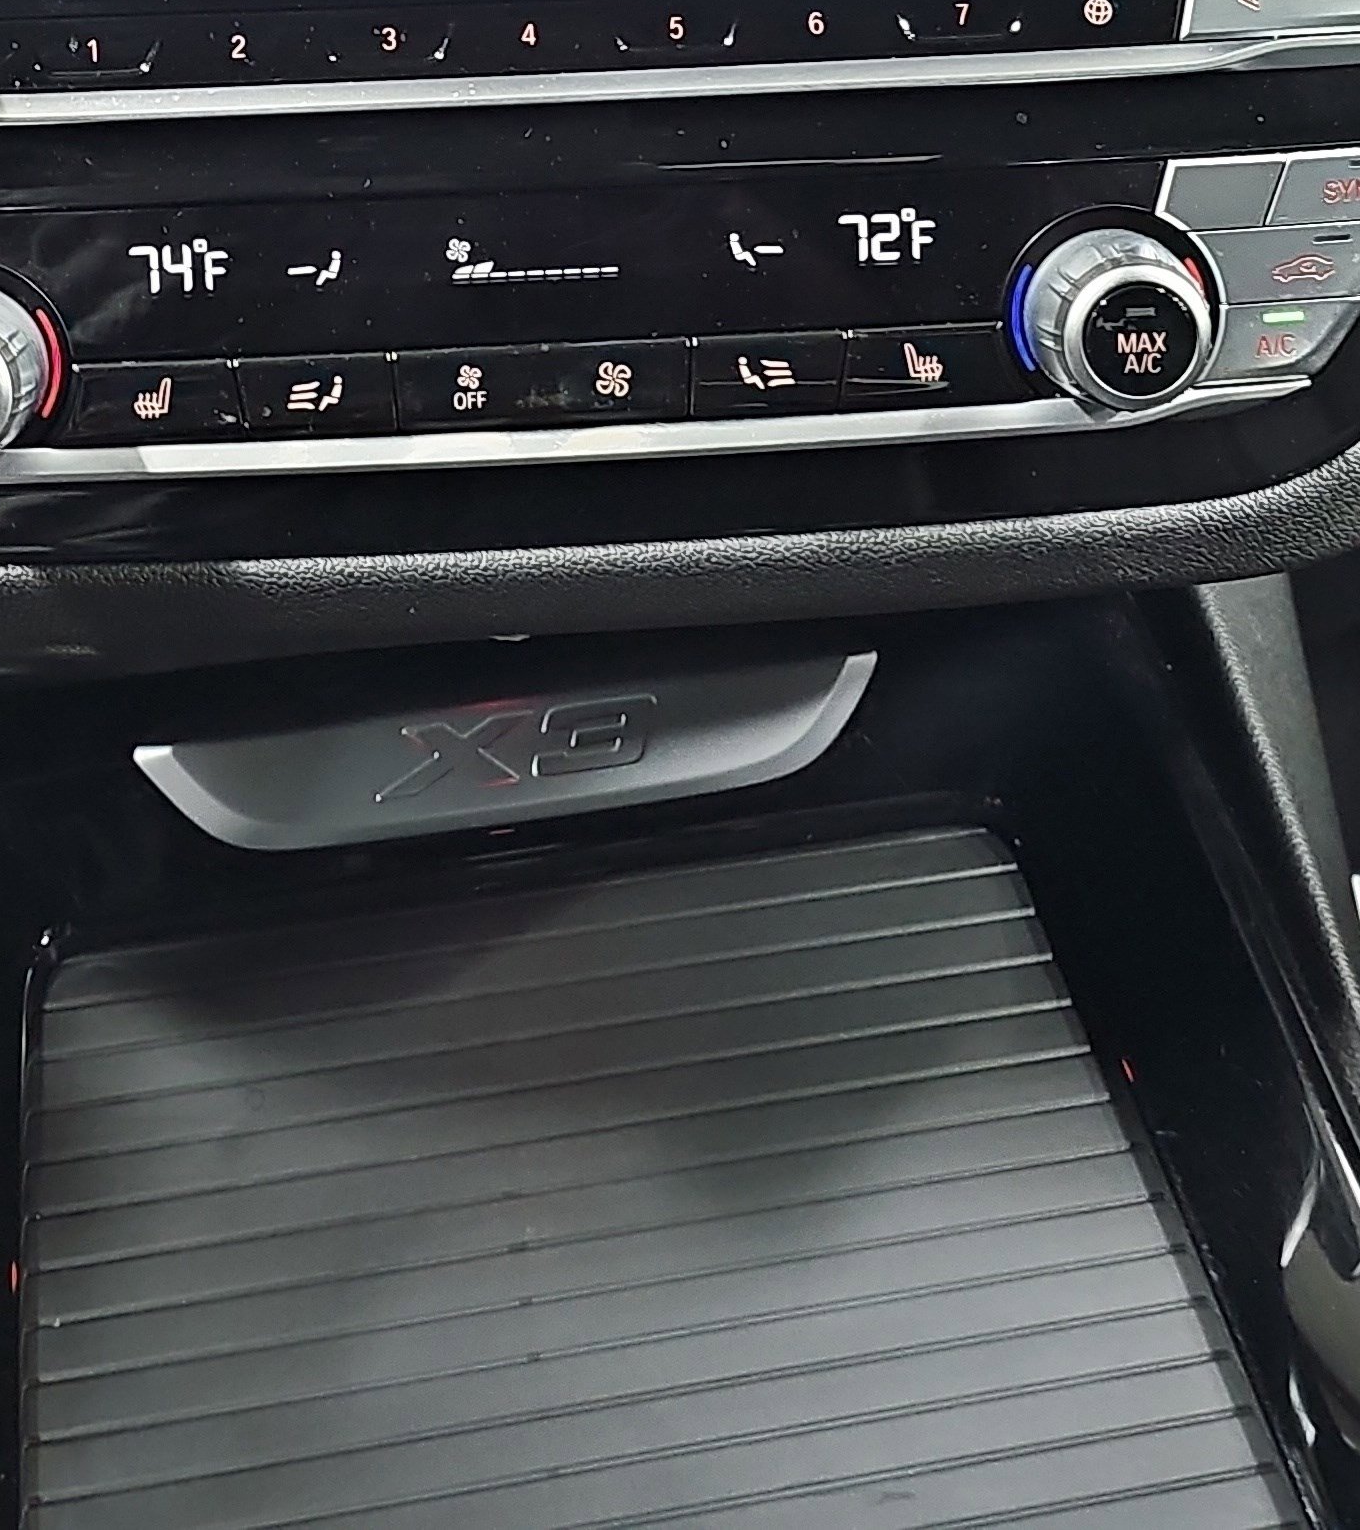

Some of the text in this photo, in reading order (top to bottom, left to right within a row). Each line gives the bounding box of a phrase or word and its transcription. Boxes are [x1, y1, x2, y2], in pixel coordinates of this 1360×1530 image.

[86, 3, 969, 63] 1 2 3 4 5 6 7
[1117, 331, 1167, 354] MAX
[1255, 333, 1298, 359] A/C
[1124, 353, 1162, 374] A/C
[453, 391, 487, 411] OFF
[373, 693, 658, 805] X3
